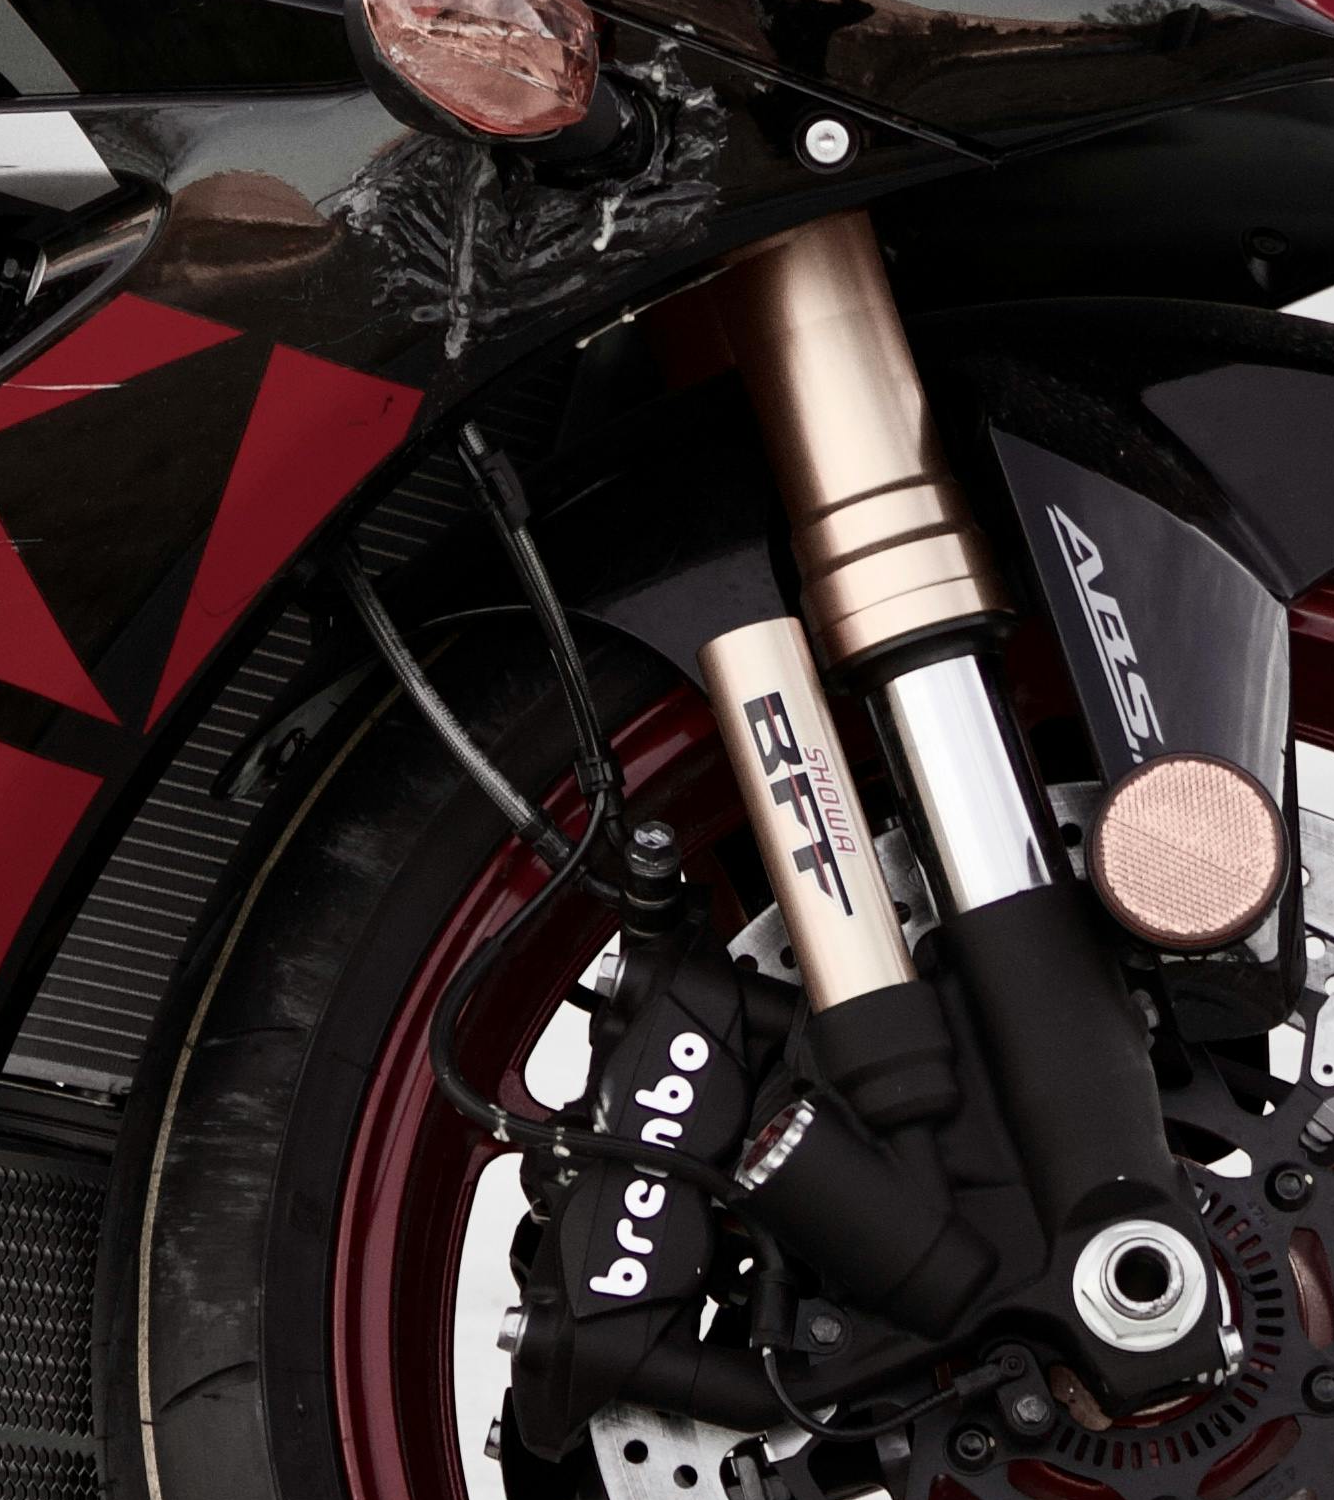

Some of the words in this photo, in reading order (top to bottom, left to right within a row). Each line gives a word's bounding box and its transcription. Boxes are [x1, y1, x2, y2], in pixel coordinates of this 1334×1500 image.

[1052, 503, 1165, 746] ABS
[743, 691, 854, 917] BFF
[804, 745, 858, 854] SHOWA
